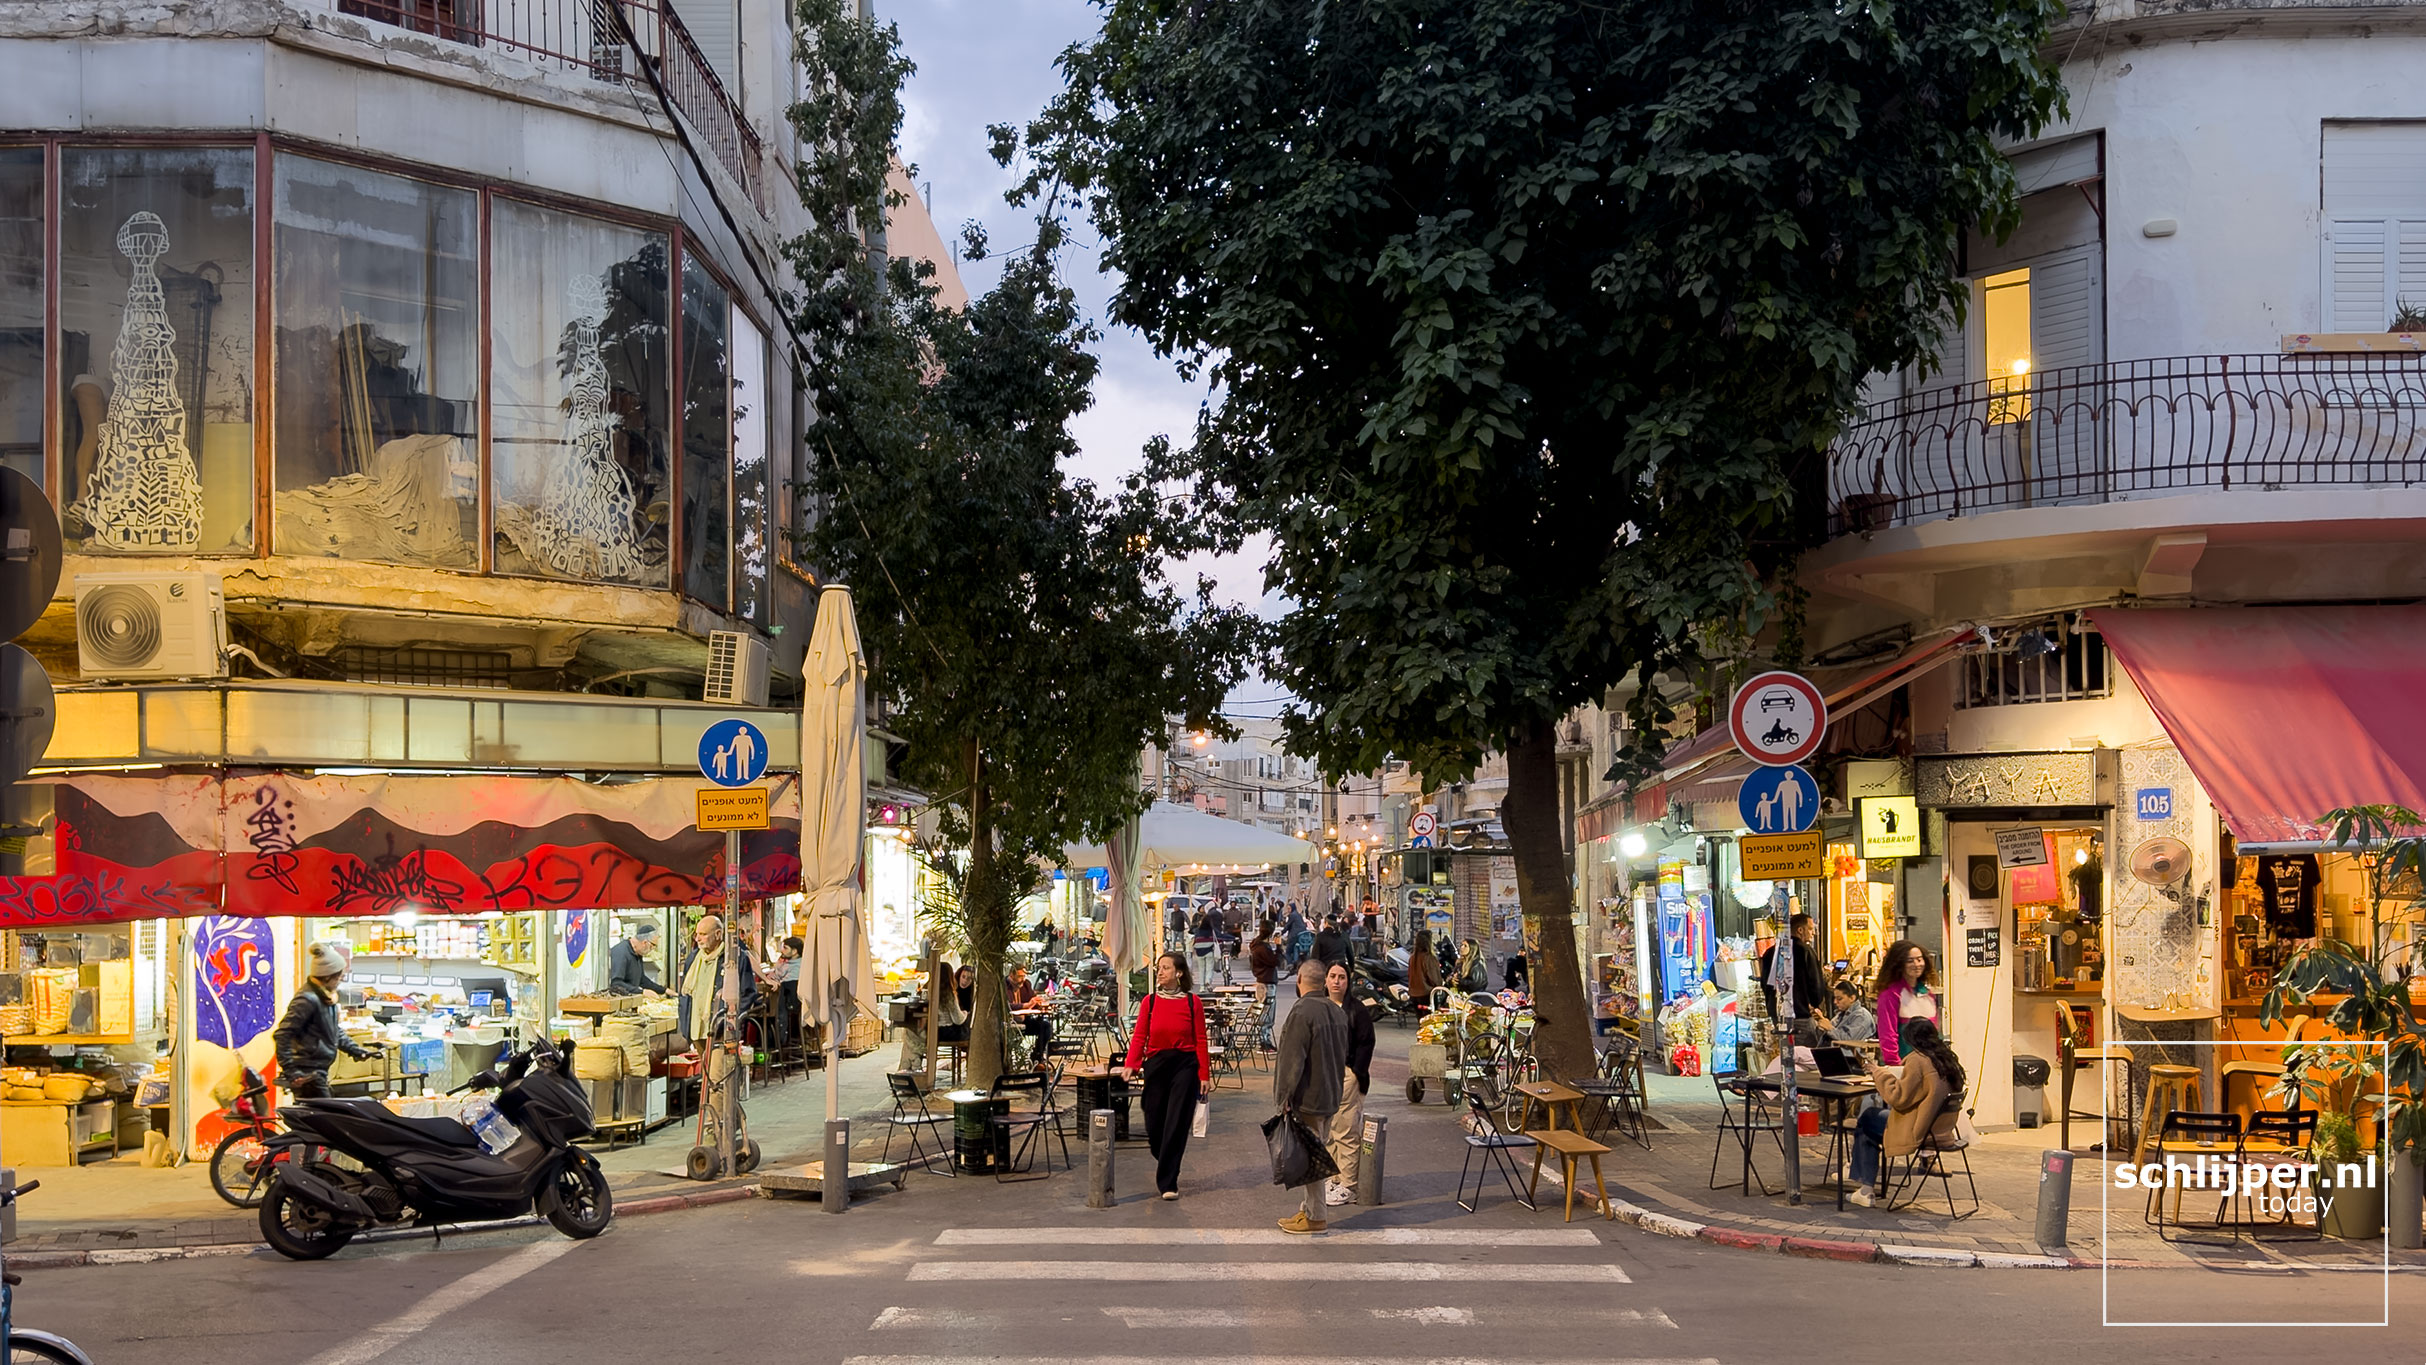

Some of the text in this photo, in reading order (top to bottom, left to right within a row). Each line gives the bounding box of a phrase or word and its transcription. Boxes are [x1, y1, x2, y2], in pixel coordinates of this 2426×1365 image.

[1946, 766, 2060, 802] YAYA
[738, 796, 763, 804] למעט
[2140, 794, 2170, 814] 105
[747, 812, 758, 820] לא
[1866, 835, 1916, 844] HAUSBRANDT
[1745, 840, 1816, 854] למעט אופניים
[1752, 859, 1812, 871] לא ממונעים
[1987, 941, 1997, 950] UP
